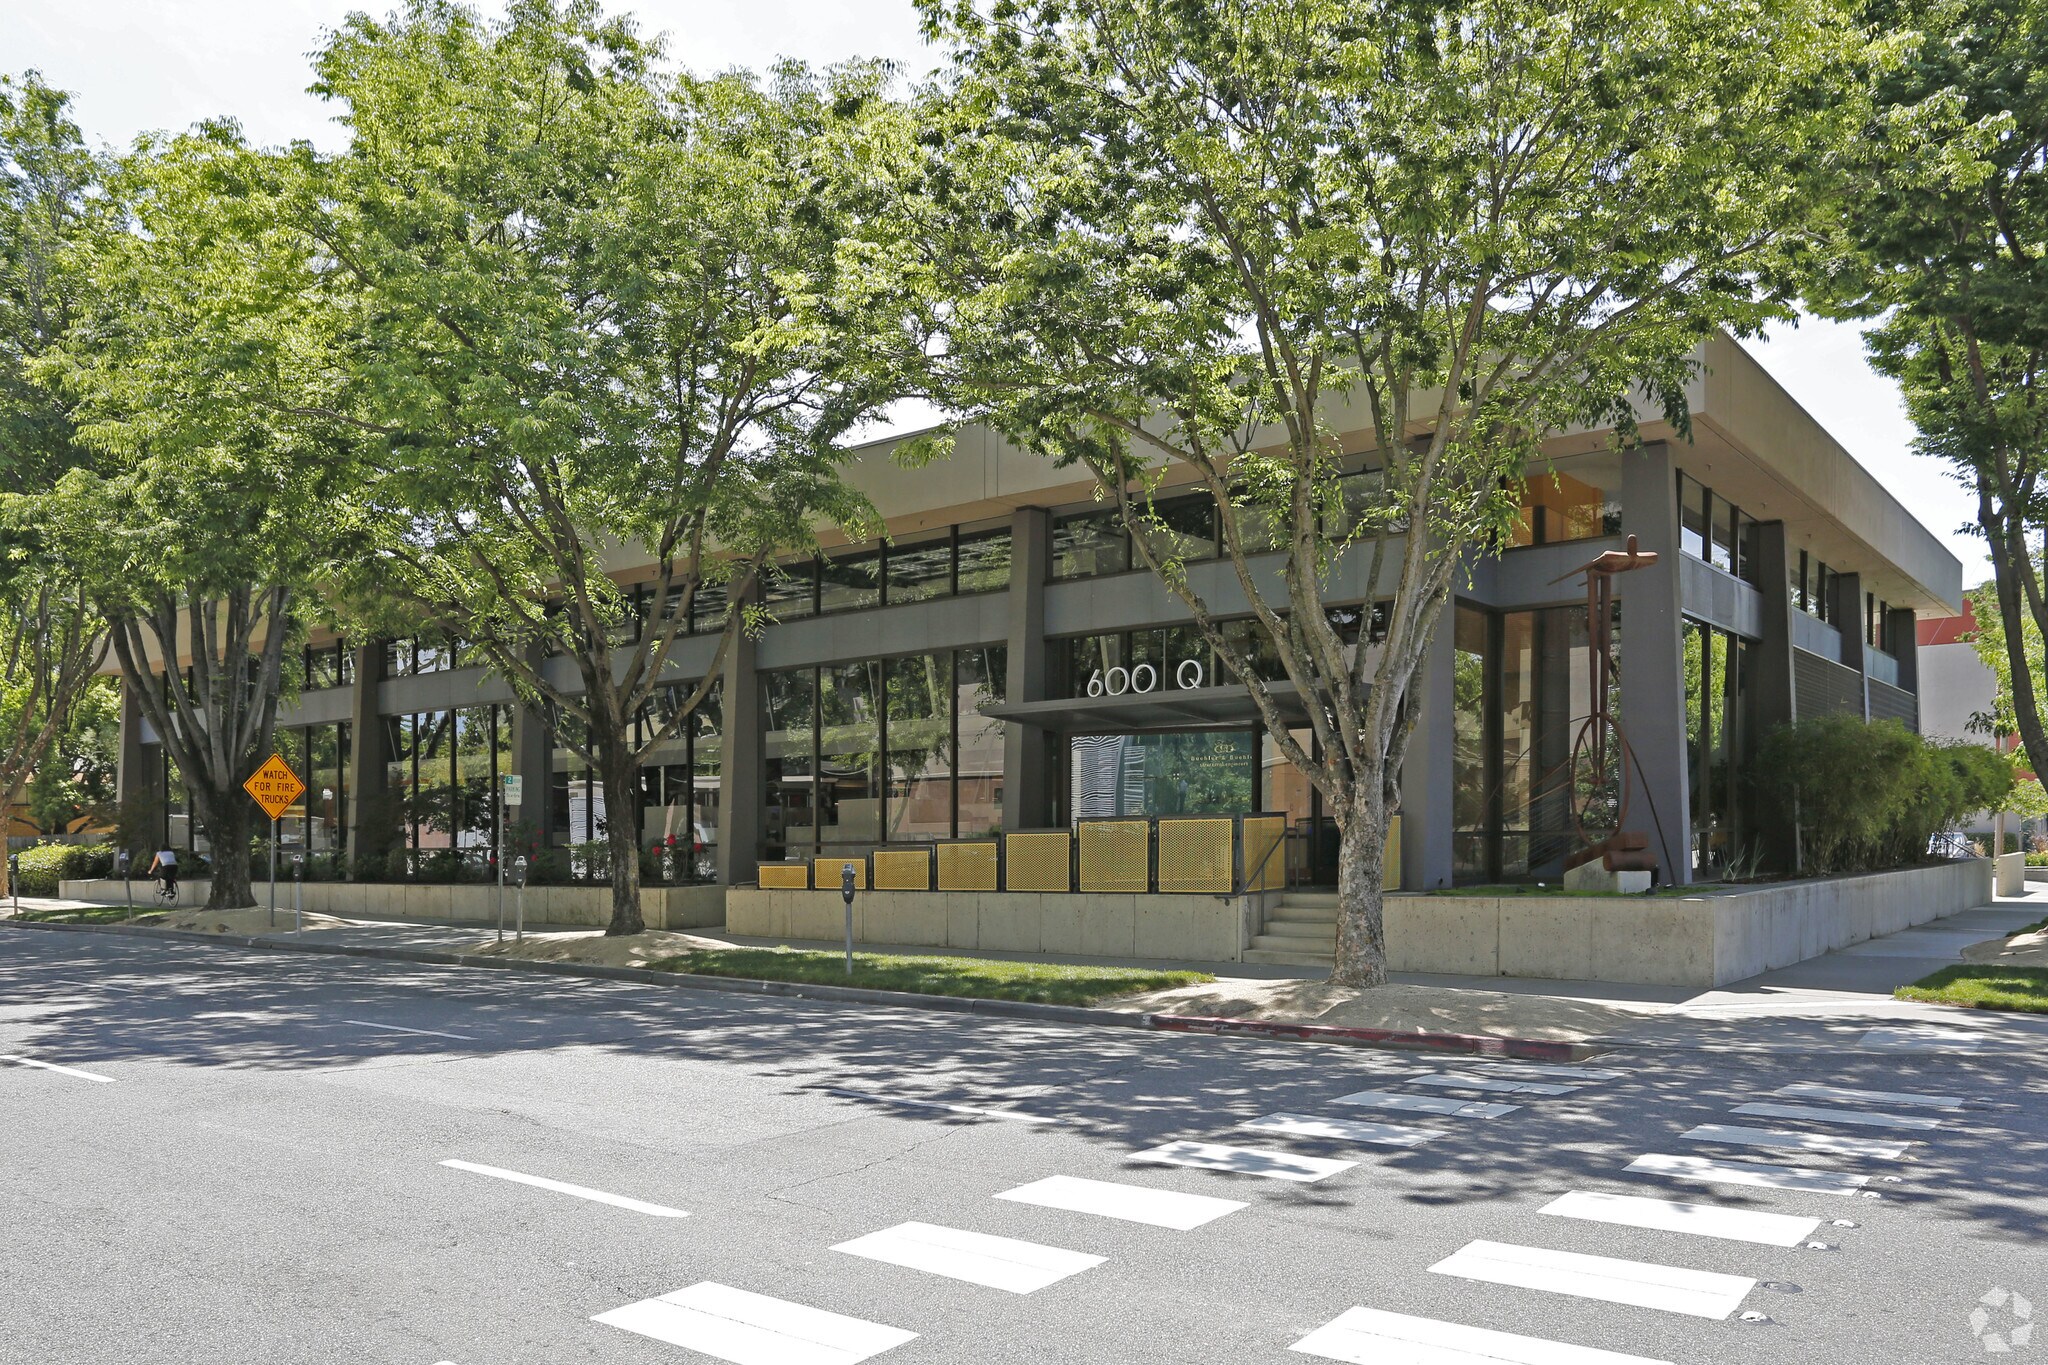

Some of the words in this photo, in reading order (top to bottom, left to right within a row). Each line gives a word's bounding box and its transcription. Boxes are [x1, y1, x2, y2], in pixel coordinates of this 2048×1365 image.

[1087, 664, 1157, 697] 600
[1177, 660, 1203, 689] Q
[263, 770, 288, 780] WATCH
[507, 776, 512, 784] 2
[254, 781, 271, 791] FOR
[277, 782, 295, 792] FIRE
[261, 794, 289, 804] TRUCKS
